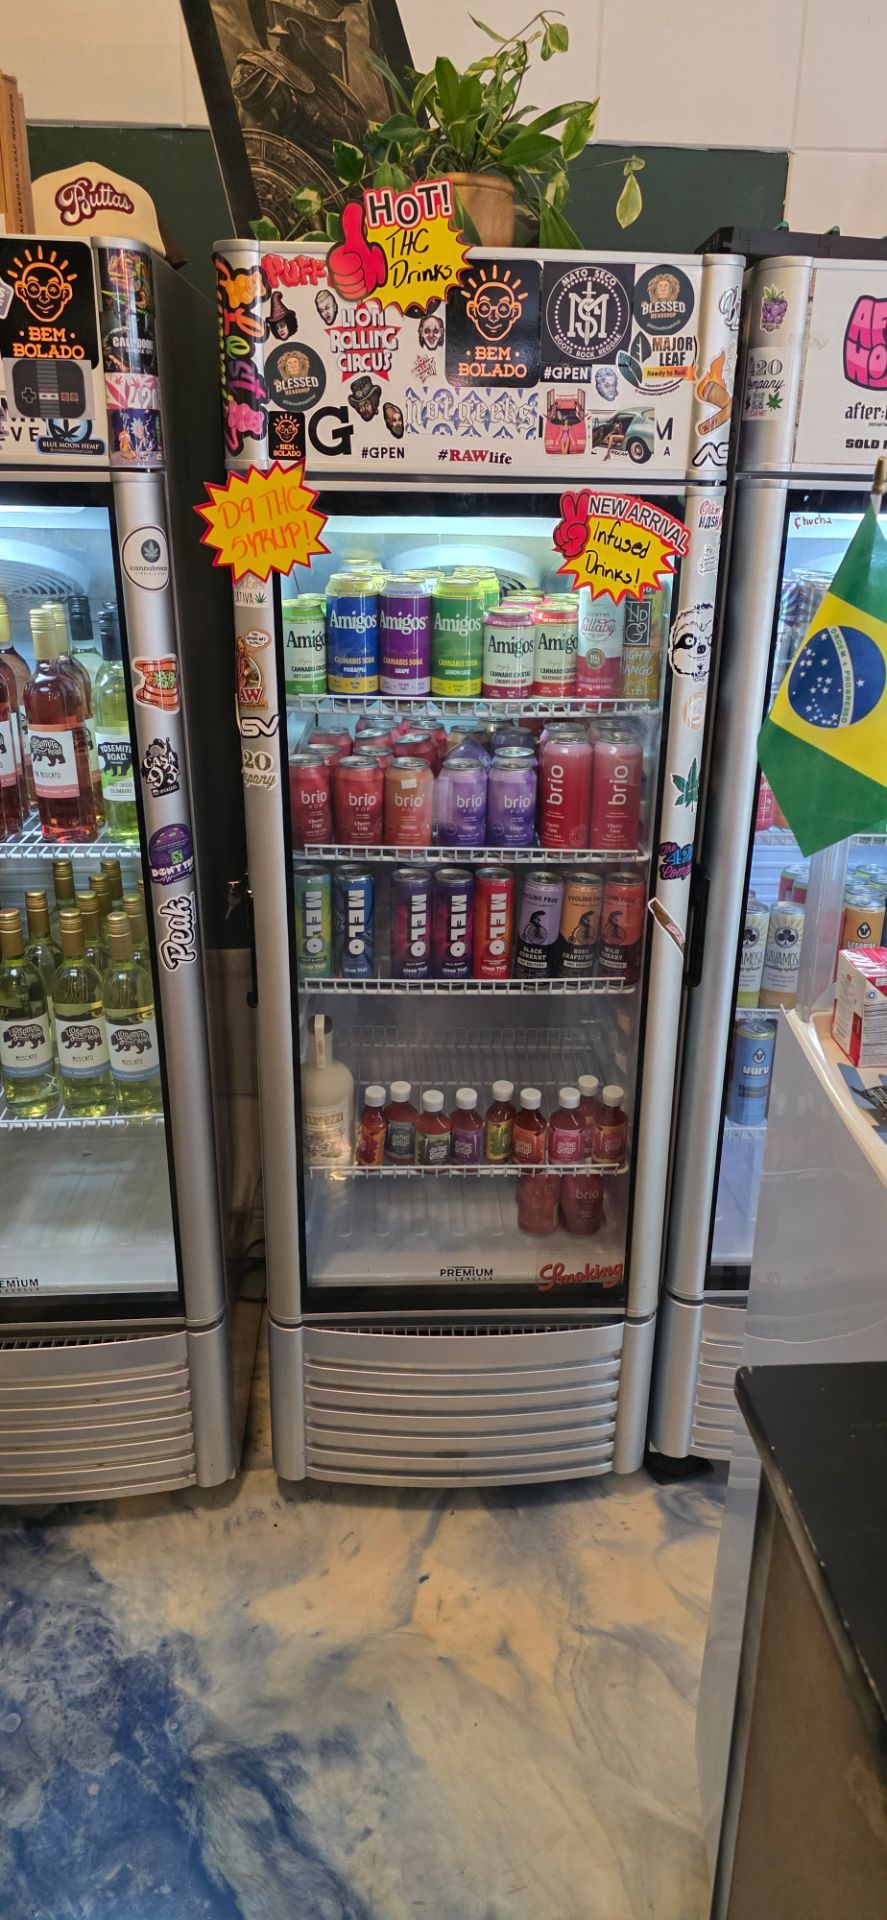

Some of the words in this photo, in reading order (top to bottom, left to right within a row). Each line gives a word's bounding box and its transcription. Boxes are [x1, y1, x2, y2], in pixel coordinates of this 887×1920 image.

[57, 180, 132, 223] Buttas
[367, 183, 451, 227] HOT!
[385, 227, 429, 259] THC
[261, 253, 333, 289] PUFF
[389, 259, 453, 289] Drinks
[561, 268, 588, 286] MATO
[594, 269, 617, 287] SECO
[342, 308, 386, 328] LION
[641, 301, 686, 316] BLESSED
[28, 326, 67, 342] BEM
[329, 328, 399, 353] ROLLING
[652, 336, 693, 352] MAJOR
[12, 343, 85, 360] BOLADO
[474, 346, 512, 361] BEM
[553, 334, 574, 355] ROOTS
[575, 350, 595, 359] ROCK
[598, 333, 623, 356] REGGAE
[337, 352, 393, 373] CIRCUS
[659, 351, 686, 367] LEAF
[458, 363, 528, 378] BOLADO
[543, 366, 589, 381] #GPEN
[646, 369, 665, 377] Ready
[274, 376, 320, 393] BLESSED
[42, 441, 58, 449] BLUE
[58, 442, 80, 450] MOON
[361, 446, 405, 459] #GPEN
[845, 438, 880, 450] SOLD
[437, 448, 513, 465] #RAWlife
[217, 496, 256, 530] D9
[259, 484, 305, 521] THC
[589, 496, 628, 516] NEW
[627, 503, 689, 553] ARRIVAL
[231, 519, 312, 560] SYRUP!
[593, 520, 651, 559] Infused
[585, 549, 641, 589] Drinks!
[329, 609, 378, 634] Amigos
[379, 608, 427, 635] Amigos
[434, 612, 481, 637] Amigos
[286, 630, 327, 652] Amigo
[488, 635, 534, 659] Amigos
[537, 632, 578, 655] Amigo
[829, 627, 847, 657] ORDEM
[841, 669, 851, 724] PROGRESSO
[243, 750, 272, 771] 20
[244, 773, 276, 790] pany
[546, 764, 565, 806] brio
[607, 765, 629, 806] brio
[300, 790, 328, 805] brio
[348, 792, 377, 807] brio
[394, 792, 423, 808] brio
[456, 794, 483, 809] brio
[504, 794, 531, 809] brio
[666, 844, 694, 864] 42
[151, 863, 183, 877] DON'T
[662, 864, 692, 880] Comp
[305, 890, 323, 954] MELO
[347, 889, 365, 956] MELO
[410, 893, 427, 957] MELO
[449, 894, 468, 958] MELO
[488, 893, 507, 956] MELO
[160, 896, 196, 969] Peak
[523, 946, 543, 954] BLACK
[15, 1053, 38, 1061] MOSCATO
[575, 1188, 599, 1201] brio
[439, 1267, 494, 1277] PREMIUM
[538, 1263, 624, 1292] Smoking
[0, 1278, 39, 1289] EMIUM
